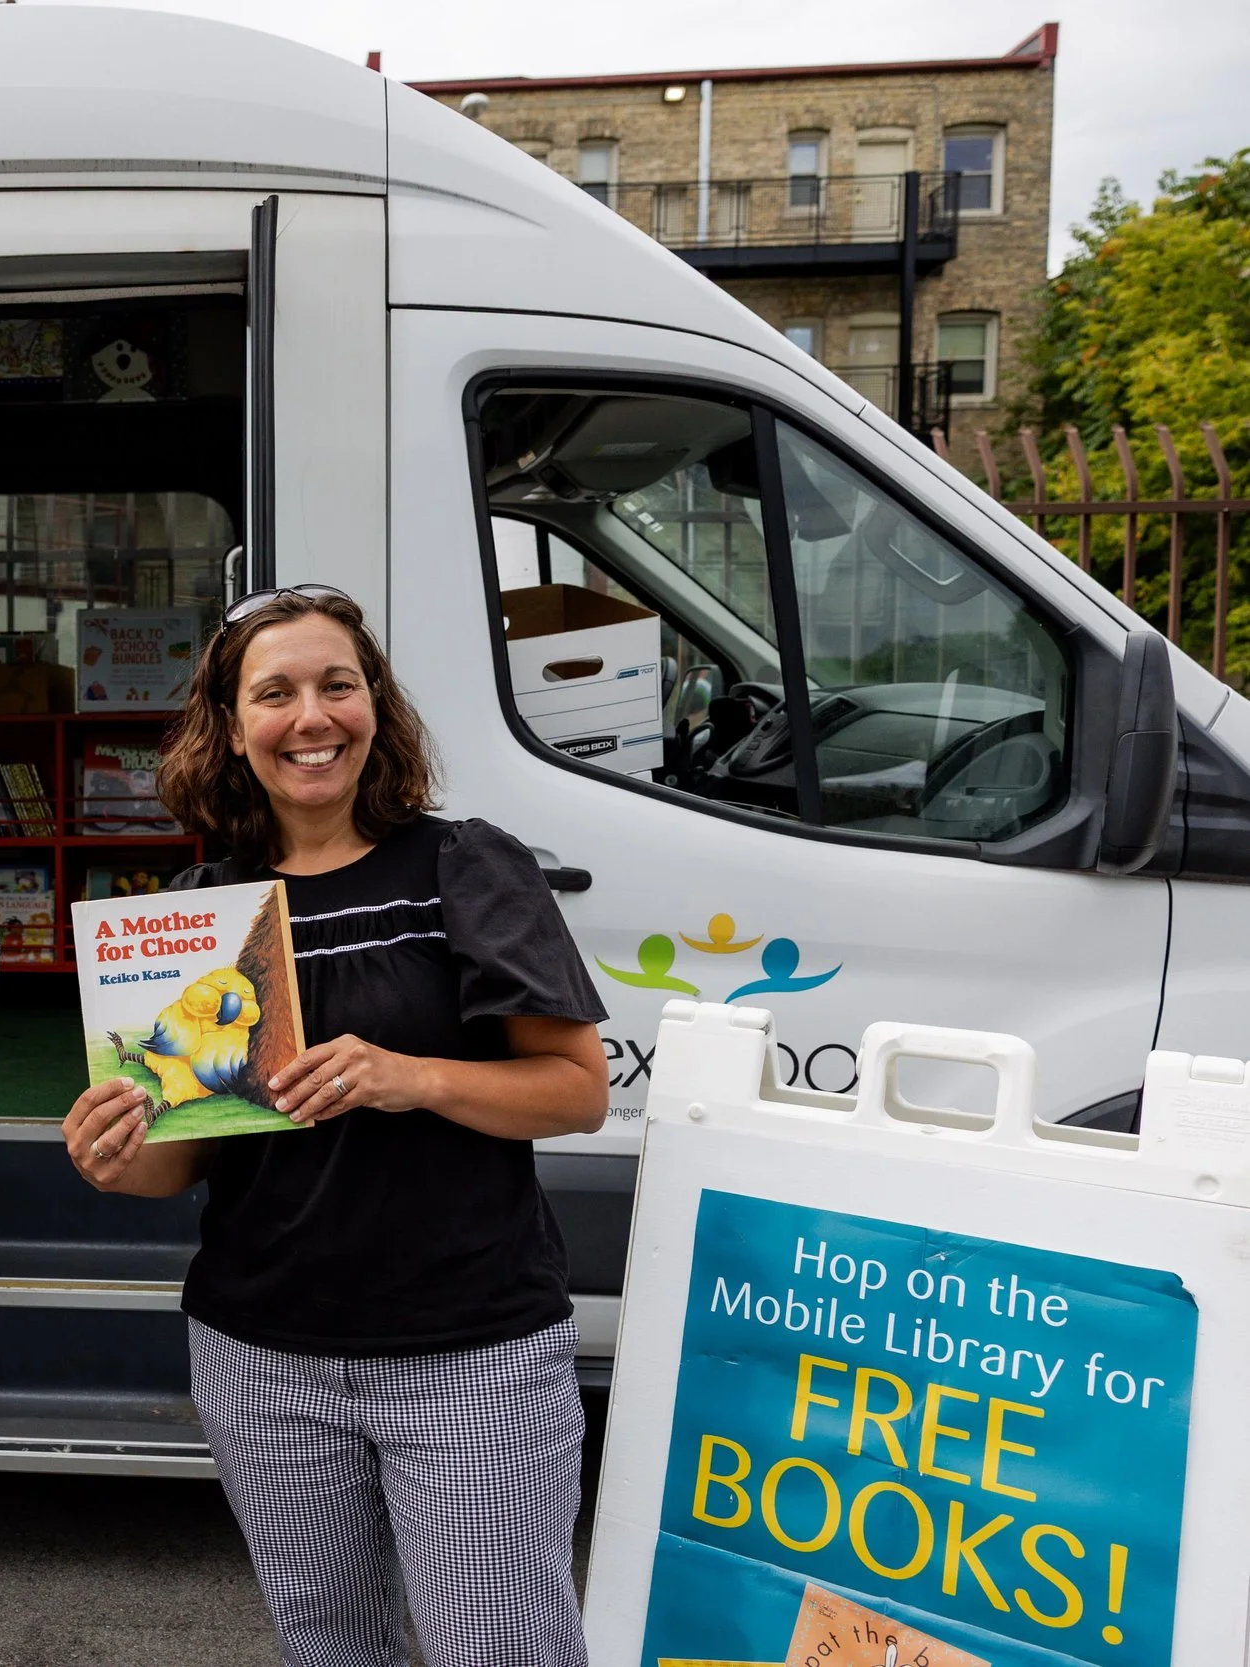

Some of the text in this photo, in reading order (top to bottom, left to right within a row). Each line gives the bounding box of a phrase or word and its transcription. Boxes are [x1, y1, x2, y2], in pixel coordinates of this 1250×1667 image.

[110, 628, 164, 640] BACK TO
[113, 640, 161, 652] SCHOOL
[112, 653, 162, 665] BUNDLES
[559, 741, 613, 754] KERS BOX
[5, 901, 49, 909] LANGUAGE
[95, 911, 216, 940] A Mother
[96, 936, 217, 962] for Choco
[99, 969, 181, 985] Keiko Kasza
[794, 1236, 1070, 1328] Hop on the
[710, 1275, 1166, 1409] Mobile Library for
[790, 1353, 1046, 1503] FREE
[692, 1433, 1129, 1646] BOOKS!
[853, 1620, 898, 1647] the
